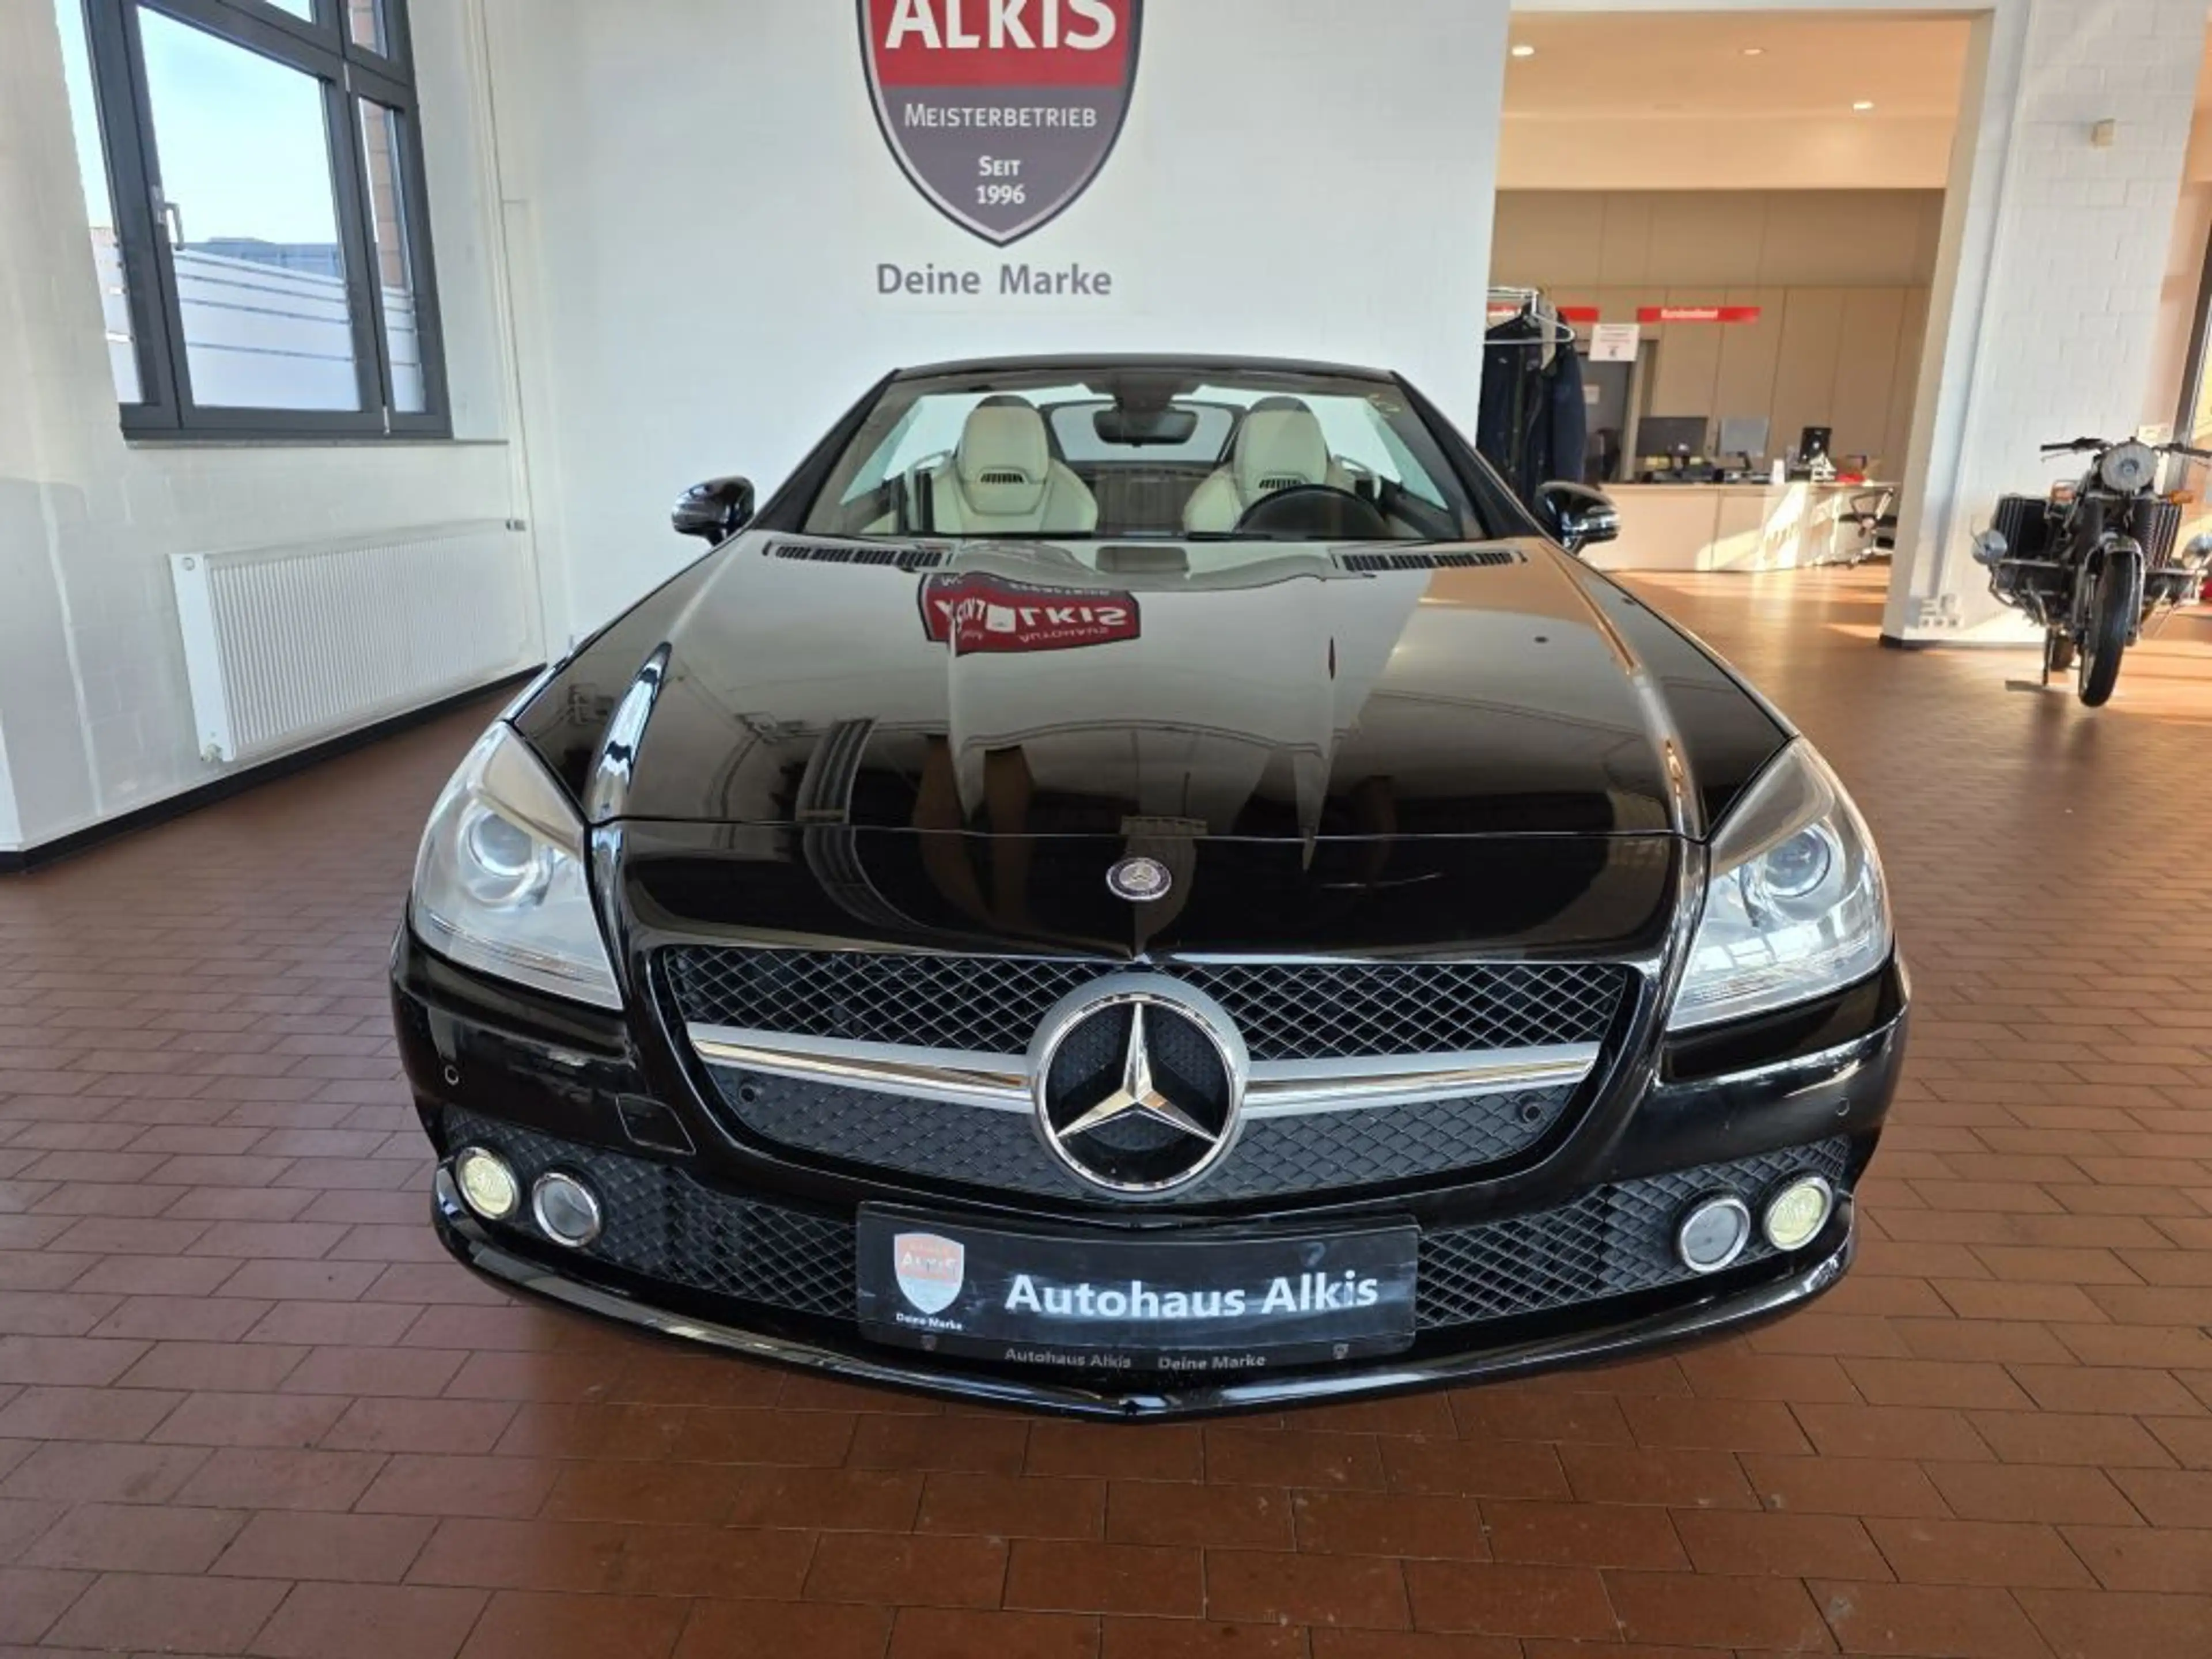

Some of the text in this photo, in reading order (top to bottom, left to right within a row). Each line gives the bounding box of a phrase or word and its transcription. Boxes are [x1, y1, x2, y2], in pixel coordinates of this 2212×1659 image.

[884, 0, 1118, 51] ALKIS
[904, 103, 1097, 127] MEISTERBETRIEB
[978, 156, 1021, 176] SEIT
[976, 185, 1025, 204] 1996
[877, 263, 1112, 294] Deine Marke
[1005, 1270, 1378, 1318] Autohaus Alkis
[1005, 1348, 1266, 1370] Autohaus Alkis Deine Marke
